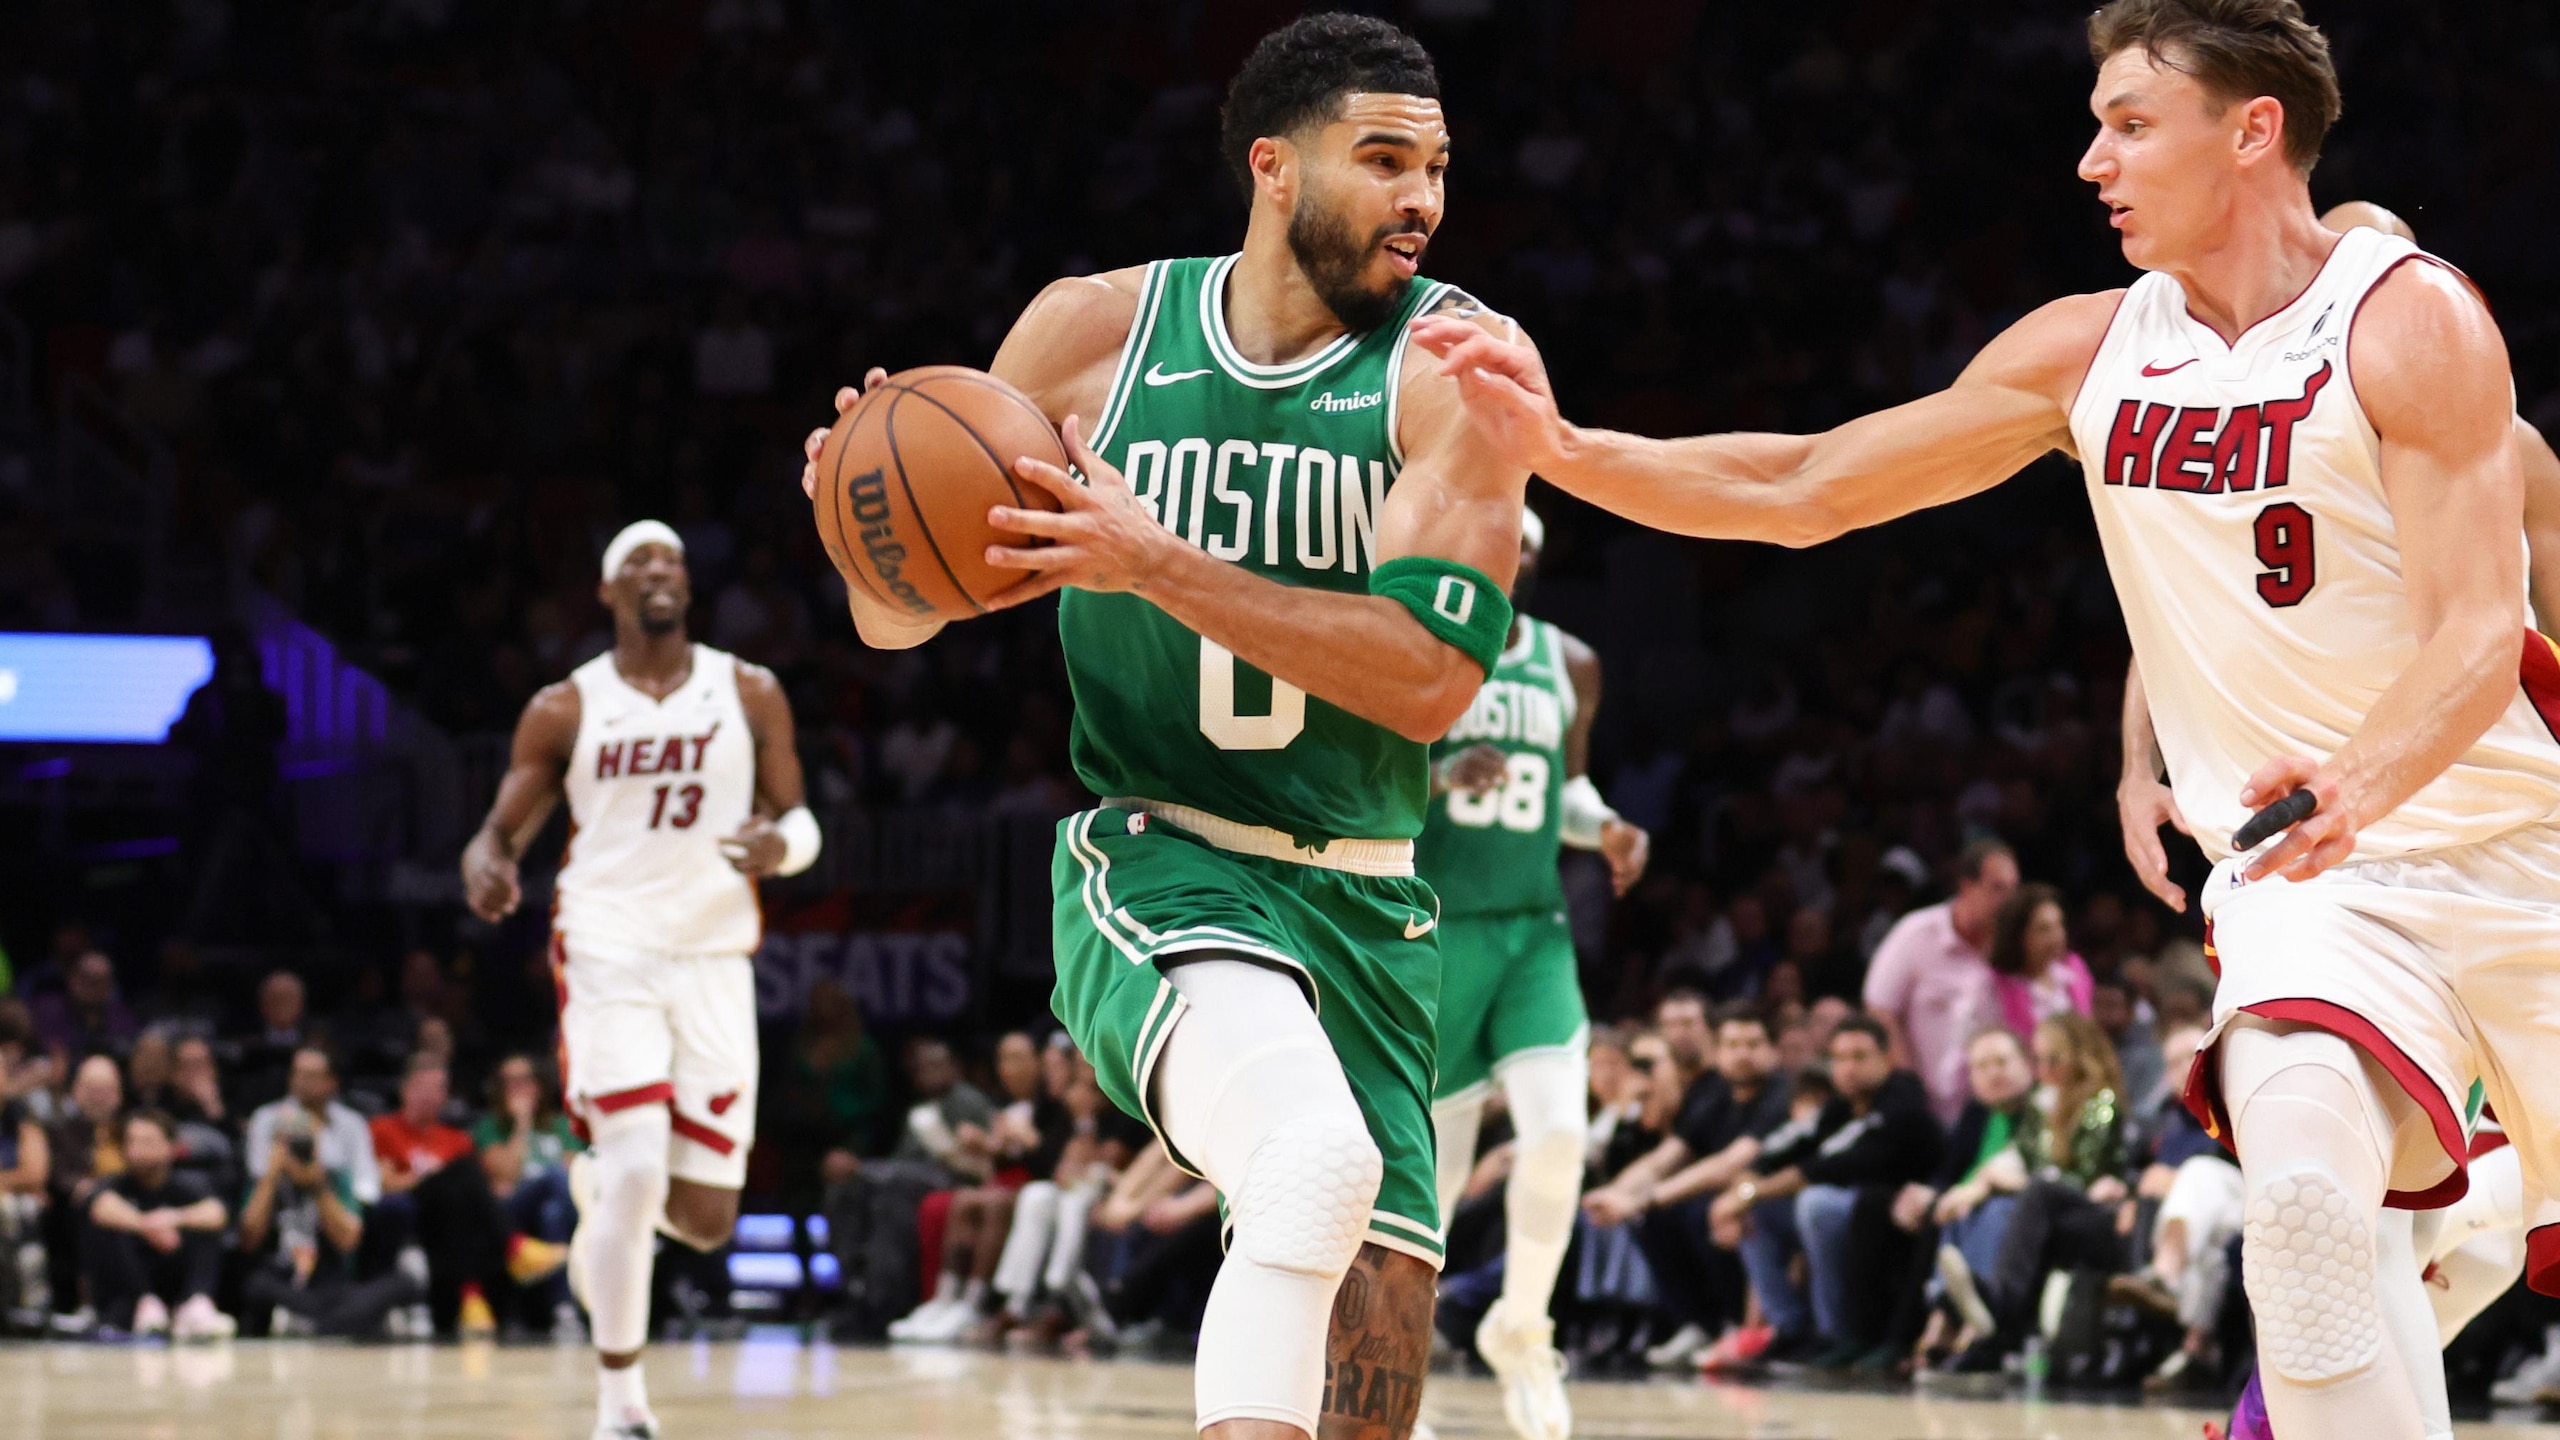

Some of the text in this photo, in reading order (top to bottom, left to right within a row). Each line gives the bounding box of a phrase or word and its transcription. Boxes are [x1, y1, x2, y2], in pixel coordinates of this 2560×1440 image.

[1310, 390, 1382, 412] Amica
[2104, 358, 2332, 494] HEAT
[849, 464, 937, 614] Wilson
[1124, 437, 1385, 575] BOSTON
[2253, 501, 2316, 609] 9
[1432, 574, 1477, 626] 0
[596, 720, 722, 781] HEAT
[649, 782, 706, 831] 13
